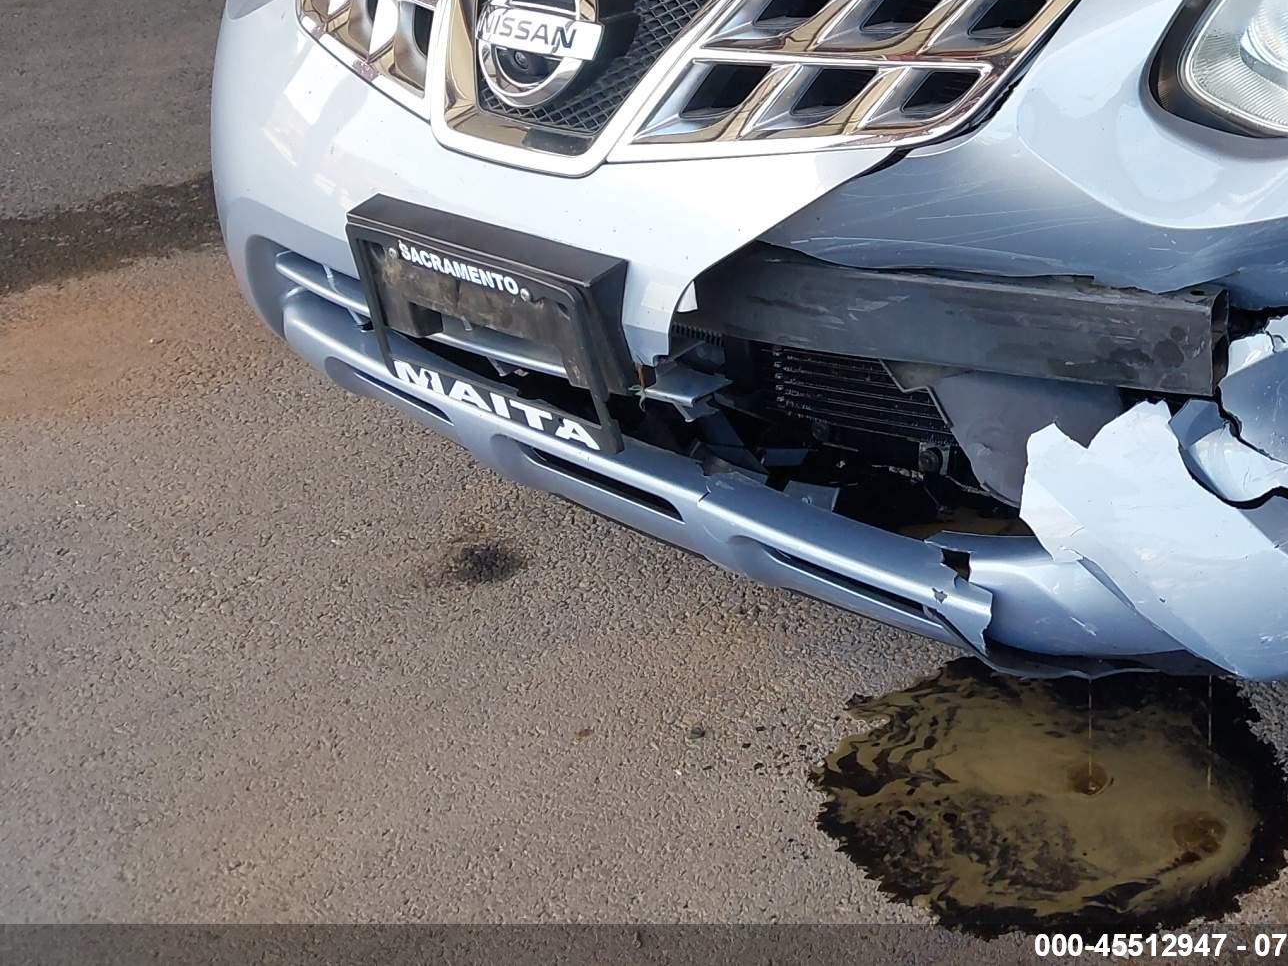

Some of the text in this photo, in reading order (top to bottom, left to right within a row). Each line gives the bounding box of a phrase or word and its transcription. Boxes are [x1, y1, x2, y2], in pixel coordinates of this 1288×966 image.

[480, 13, 577, 53] NISSAN
[398, 240, 519, 295] SACRAMENTO
[394, 360, 601, 451] MAITA
